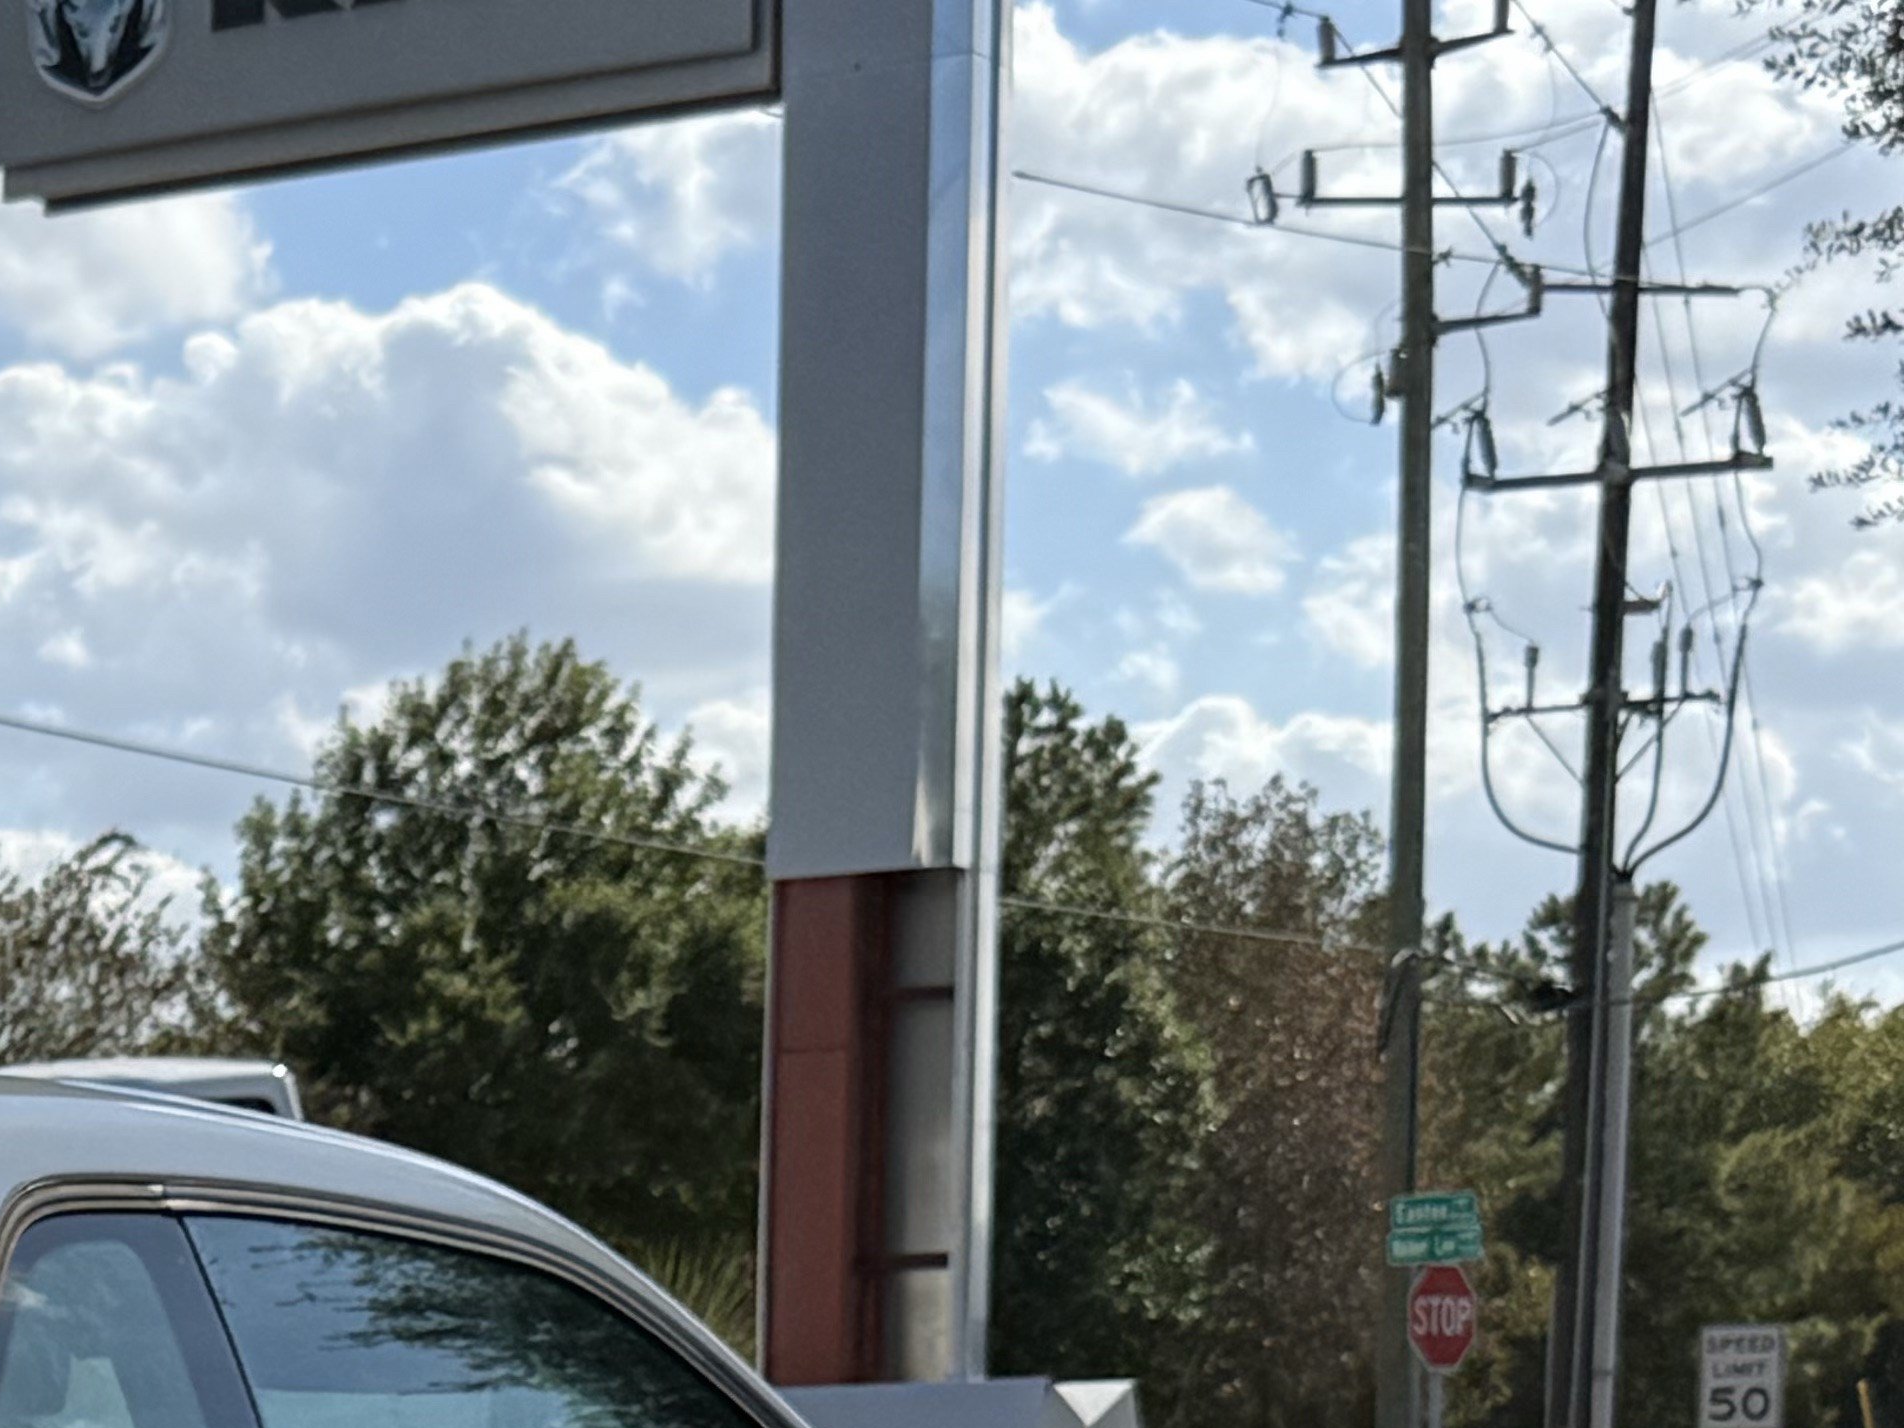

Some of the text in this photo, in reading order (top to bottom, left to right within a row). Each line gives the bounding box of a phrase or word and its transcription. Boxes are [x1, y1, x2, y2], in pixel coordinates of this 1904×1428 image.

[1413, 1295, 1472, 1336] STOP
[1706, 1335, 1776, 1354] SPEED
[1711, 1361, 1766, 1378] LIMIT
[1707, 1386, 1771, 1422] 50
